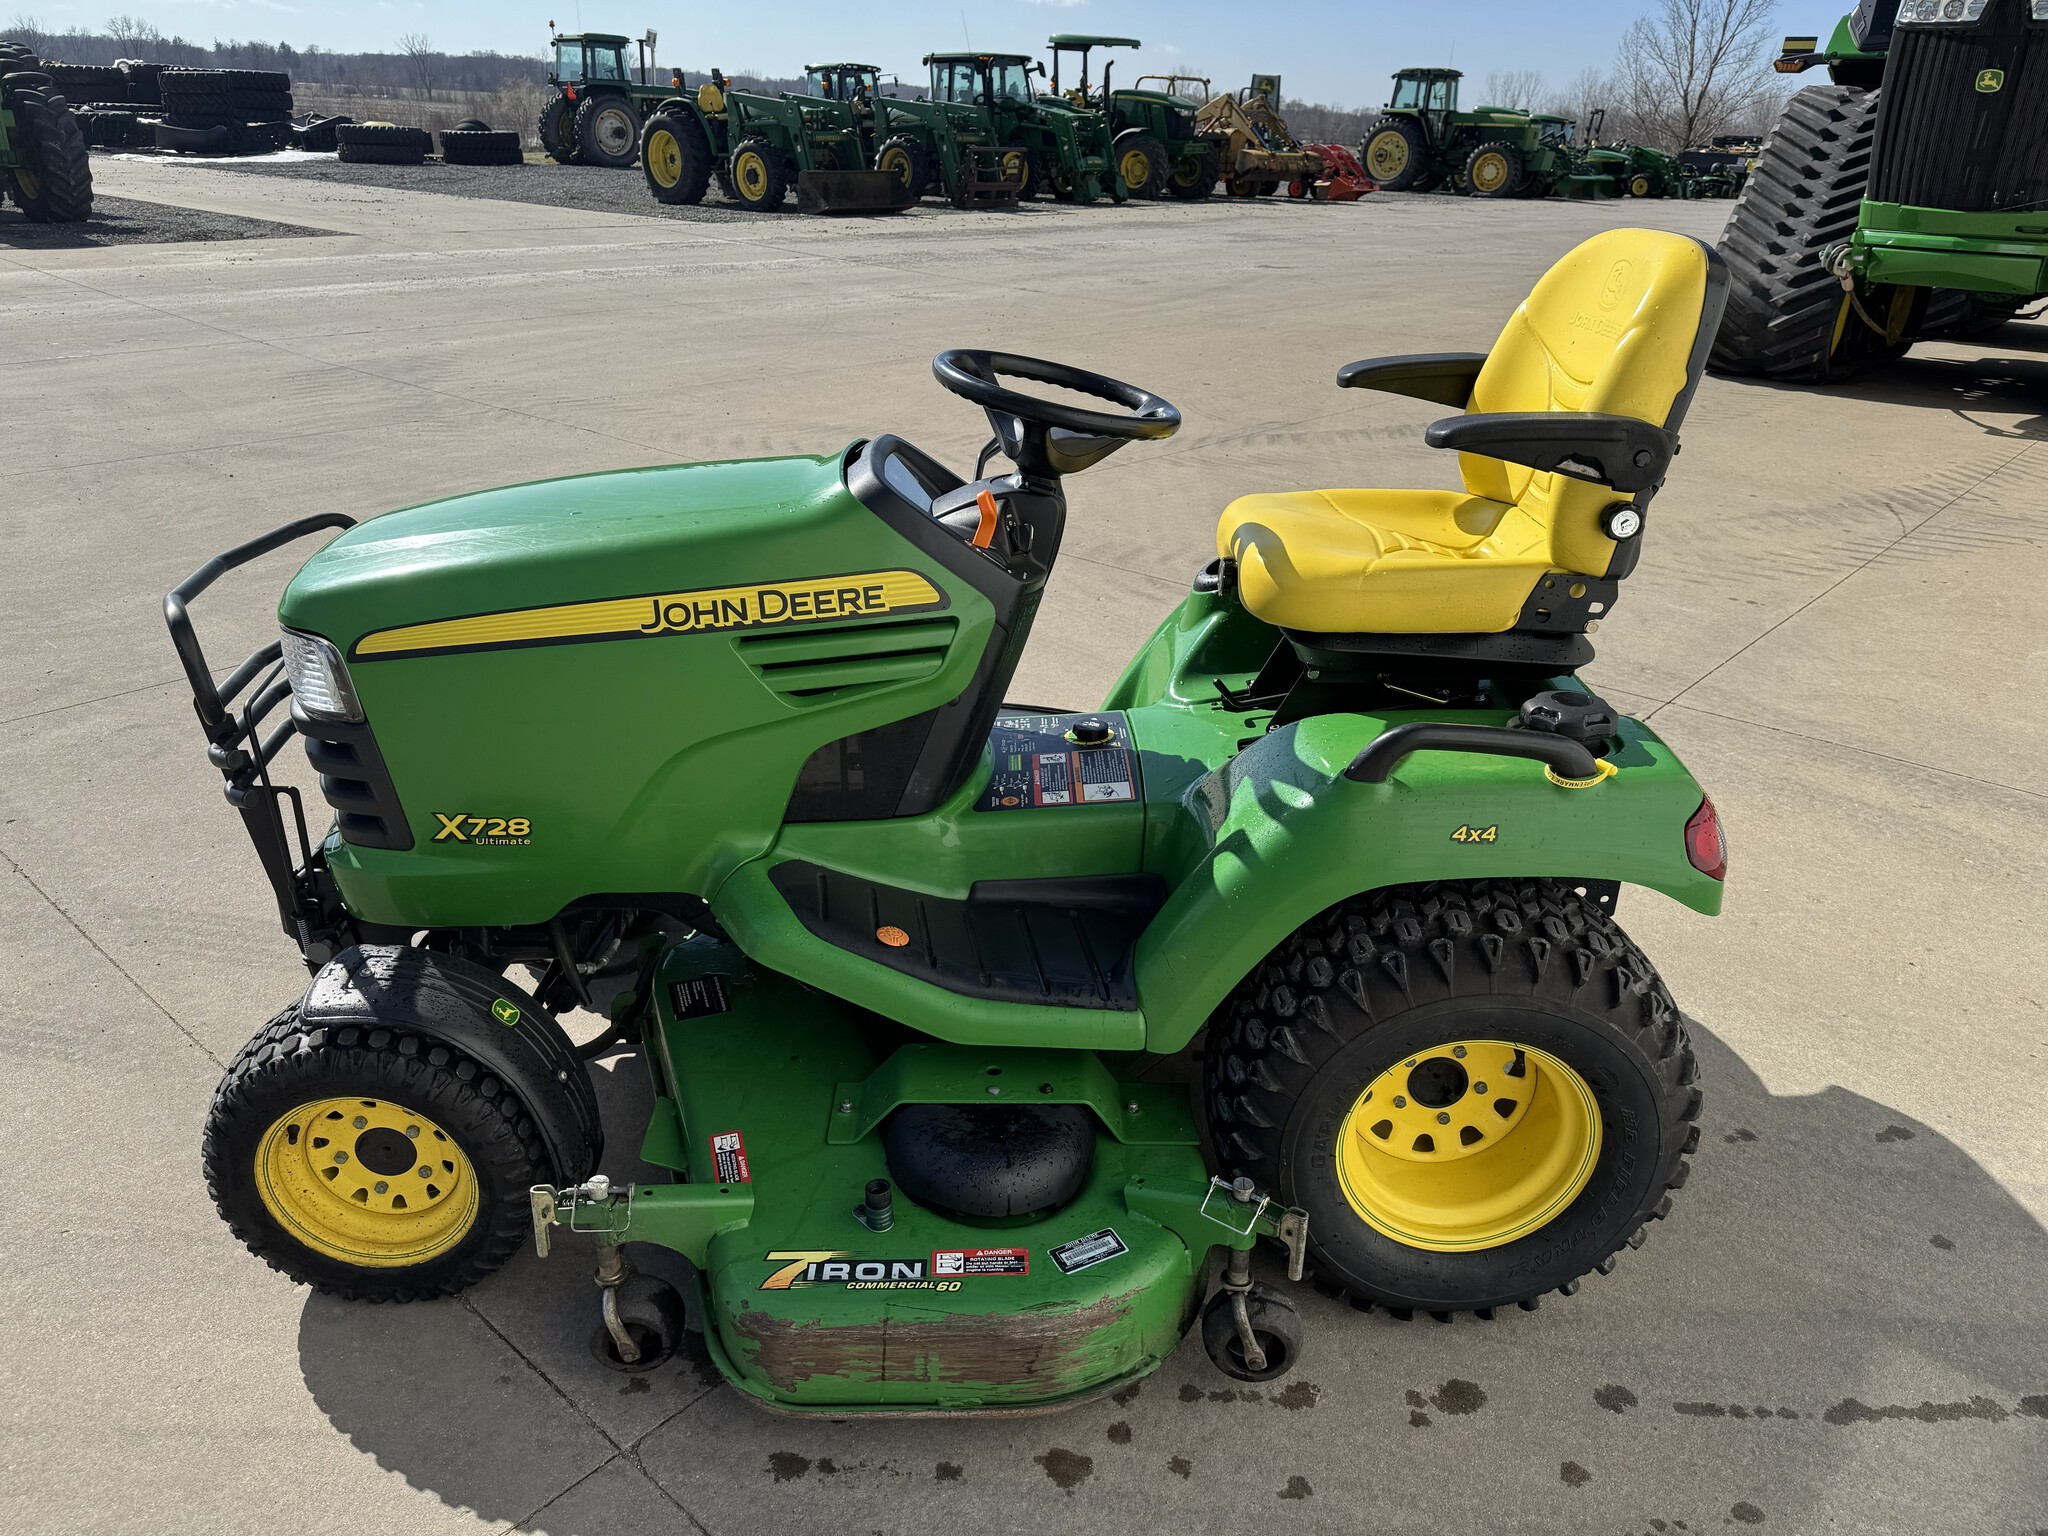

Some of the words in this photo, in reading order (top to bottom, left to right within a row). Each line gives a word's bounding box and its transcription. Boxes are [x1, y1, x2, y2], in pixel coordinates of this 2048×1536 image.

[641, 598, 748, 634] JOHN
[757, 584, 887, 621] DEERE
[1554, 777, 1595, 789] GREENMARK
[432, 812, 531, 841] X728
[1451, 825, 1498, 843] 4x4
[474, 836, 532, 846] Ultimate
[1590, 1150, 1638, 1227] FIELD
